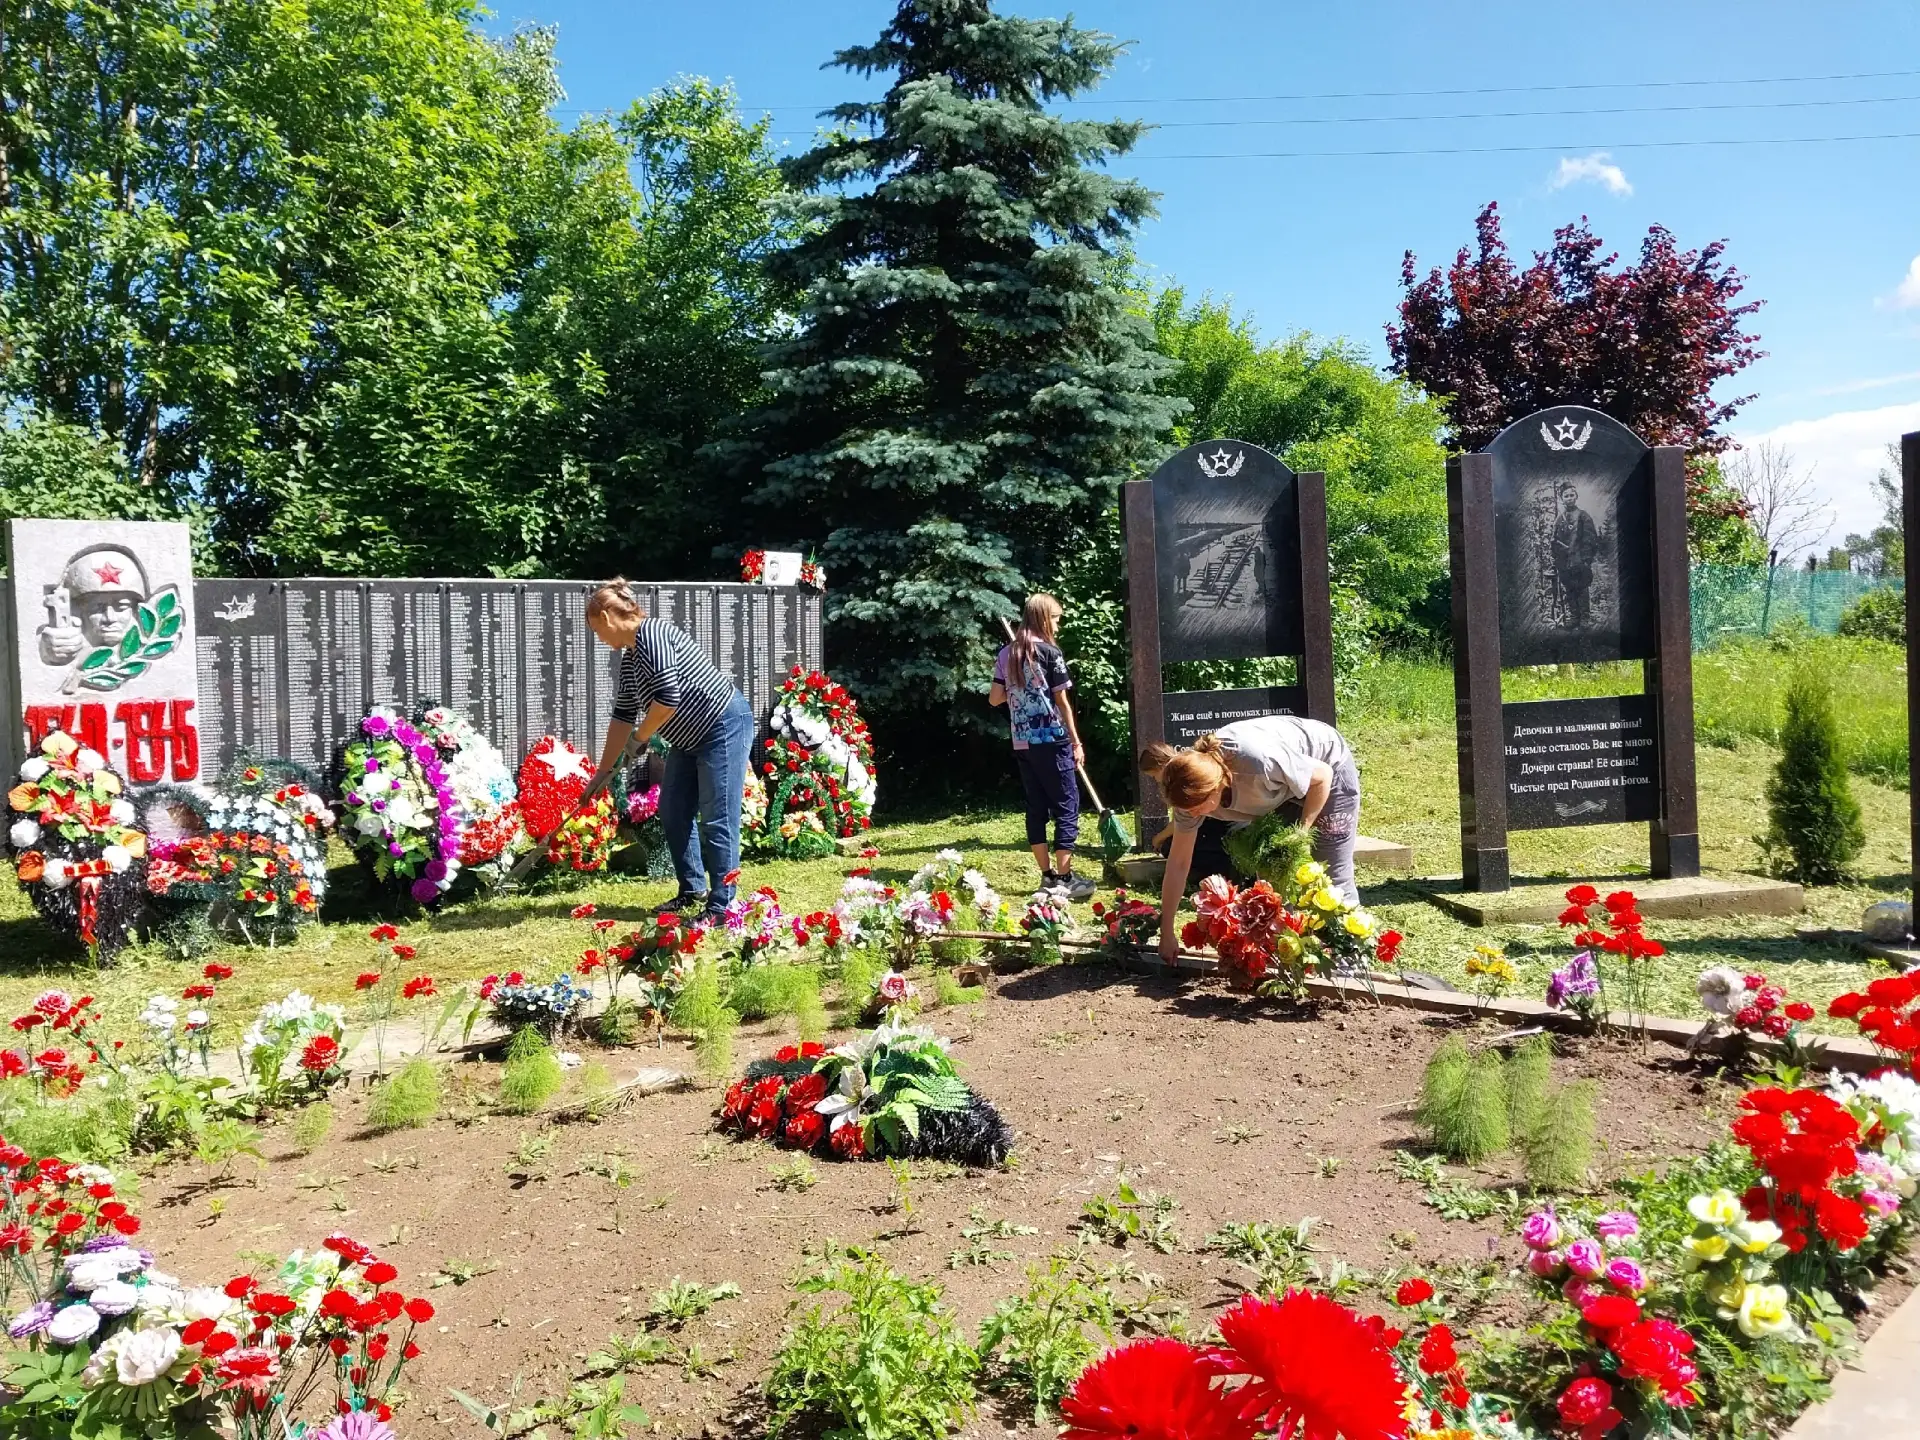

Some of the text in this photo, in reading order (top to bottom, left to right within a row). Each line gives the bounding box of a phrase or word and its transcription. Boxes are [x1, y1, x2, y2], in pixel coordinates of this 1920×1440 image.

[1170, 712, 1194, 722] Жива
[1196, 711, 1213, 720] ещё
[1221, 710, 1260, 719] потомках
[1180, 728, 1196, 737] Тех
[1513, 718, 1642, 738] Девочки и мальчики войны!
[1504, 738, 1653, 756] На земле осталось Вас не много
[1520, 756, 1639, 775] Дочери страны! Её сыны!
[1509, 776, 1651, 794] Чистые пред Родиной и Богом.
